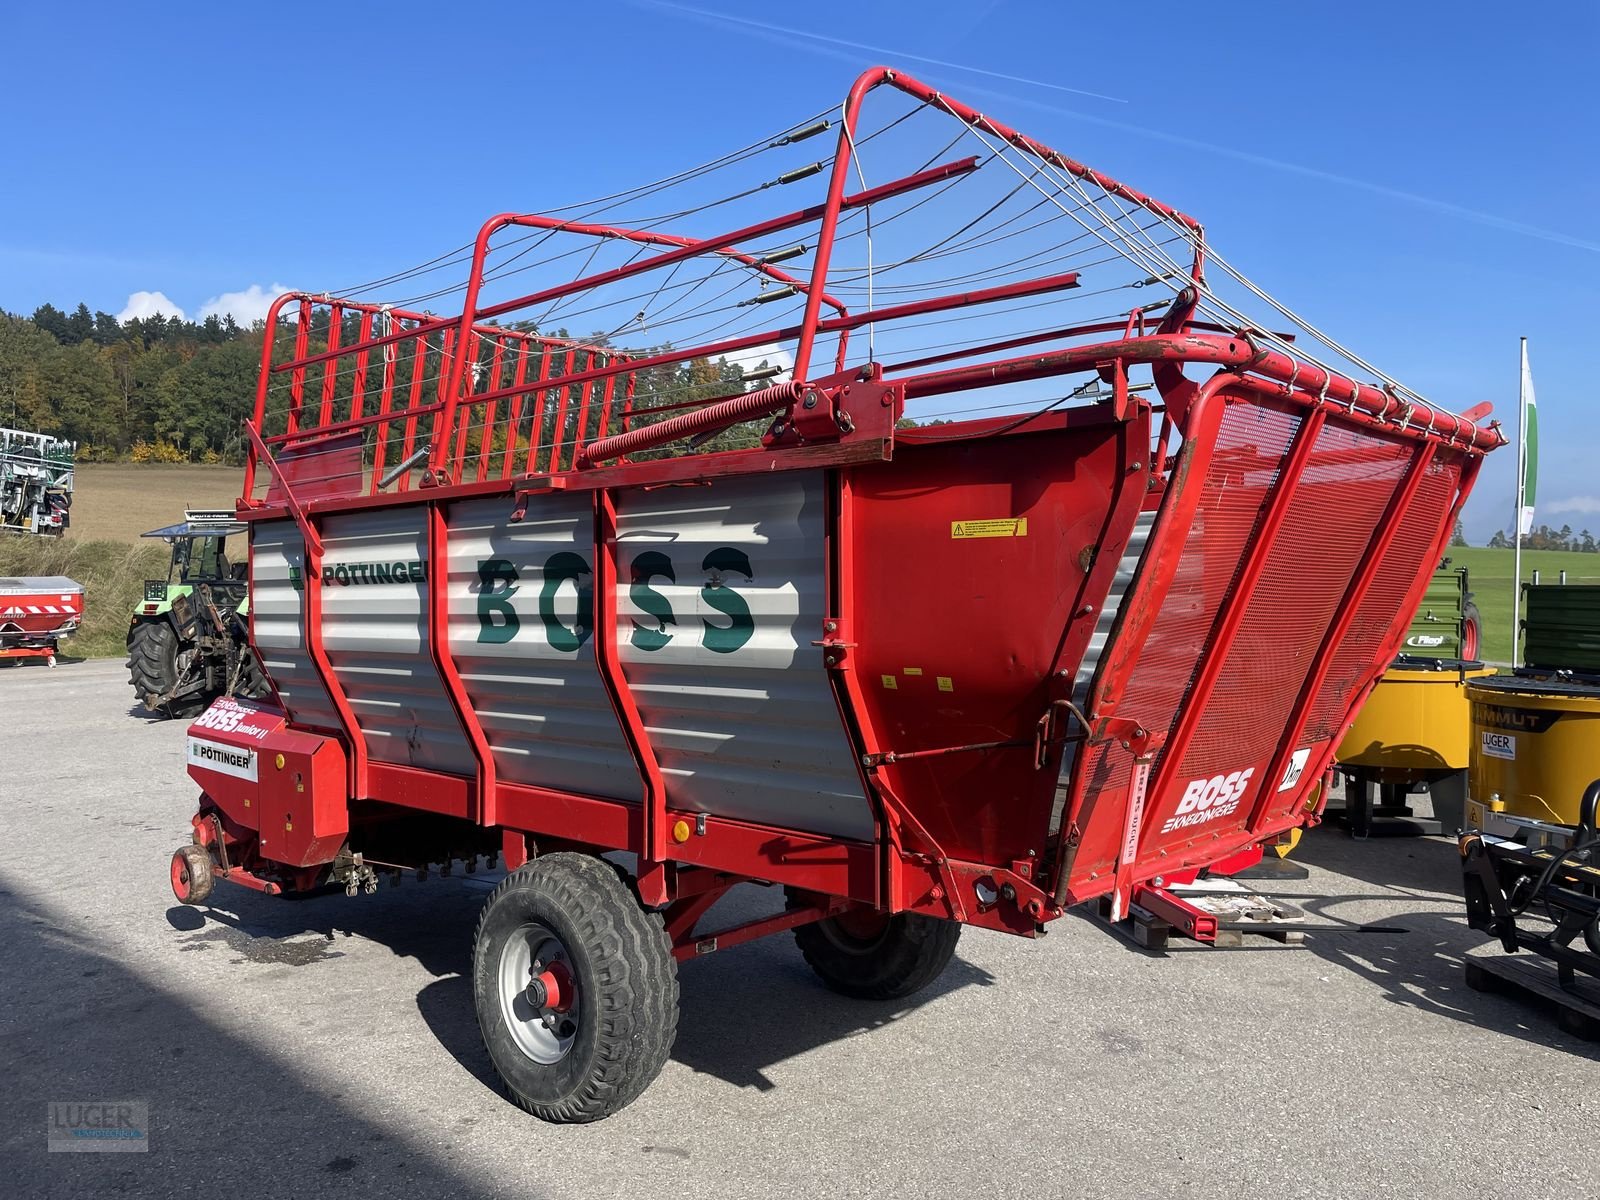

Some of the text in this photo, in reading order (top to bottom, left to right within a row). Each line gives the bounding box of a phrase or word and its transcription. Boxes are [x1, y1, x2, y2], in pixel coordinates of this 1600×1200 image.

[322, 562, 428, 586] PÖTTINGE
[477, 547, 756, 653] BOSS
[194, 707, 246, 732] BOSS
[1482, 733, 1510, 749] LUGER
[200, 746, 249, 769] PÖTTINGER
[1175, 767, 1255, 815] BOSS
